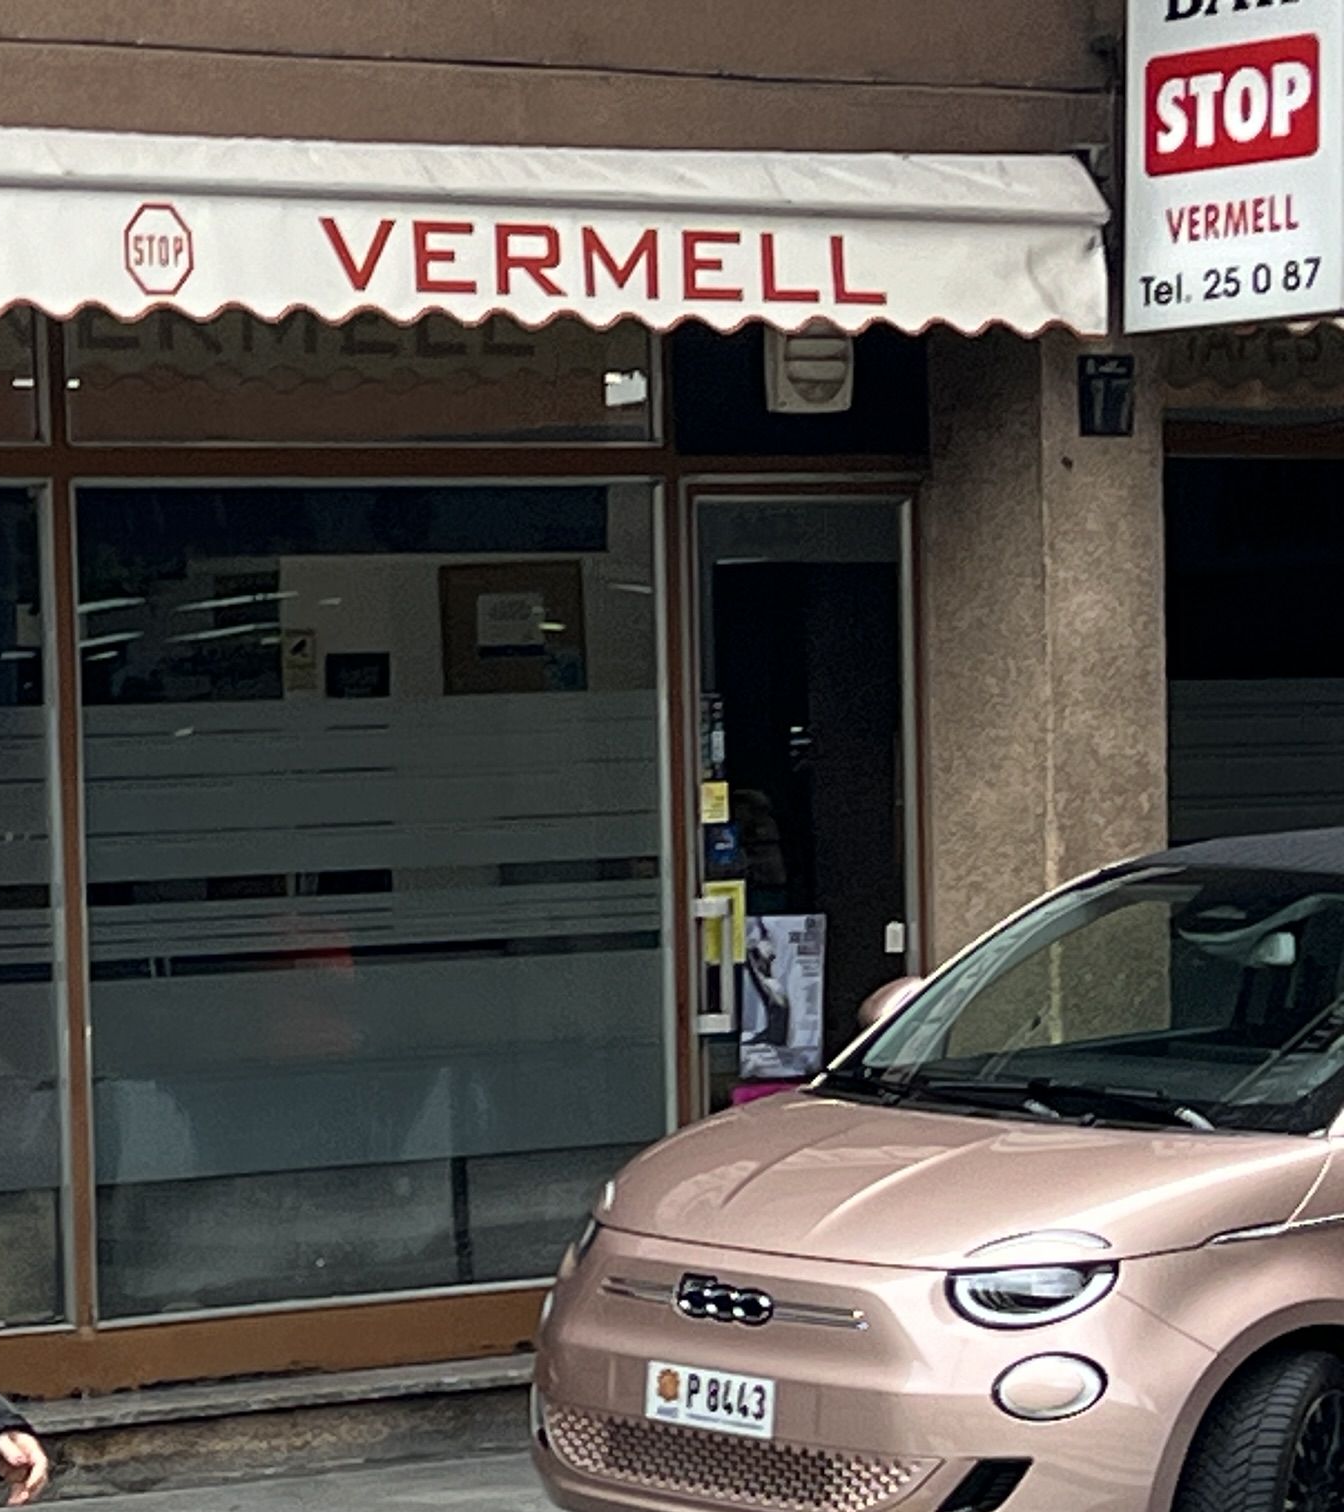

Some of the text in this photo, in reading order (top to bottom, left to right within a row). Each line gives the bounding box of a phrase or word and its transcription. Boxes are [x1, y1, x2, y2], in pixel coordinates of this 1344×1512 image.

[1155, 61, 1312, 155] STOP
[1166, 194, 1300, 244] VERMELL
[132, 234, 183, 269] STOP
[322, 217, 884, 304] VERMELL
[1139, 257, 1322, 307] Tel. 25 0 87
[676, 1271, 775, 1326] 500
[685, 1372, 767, 1421] P 8443
